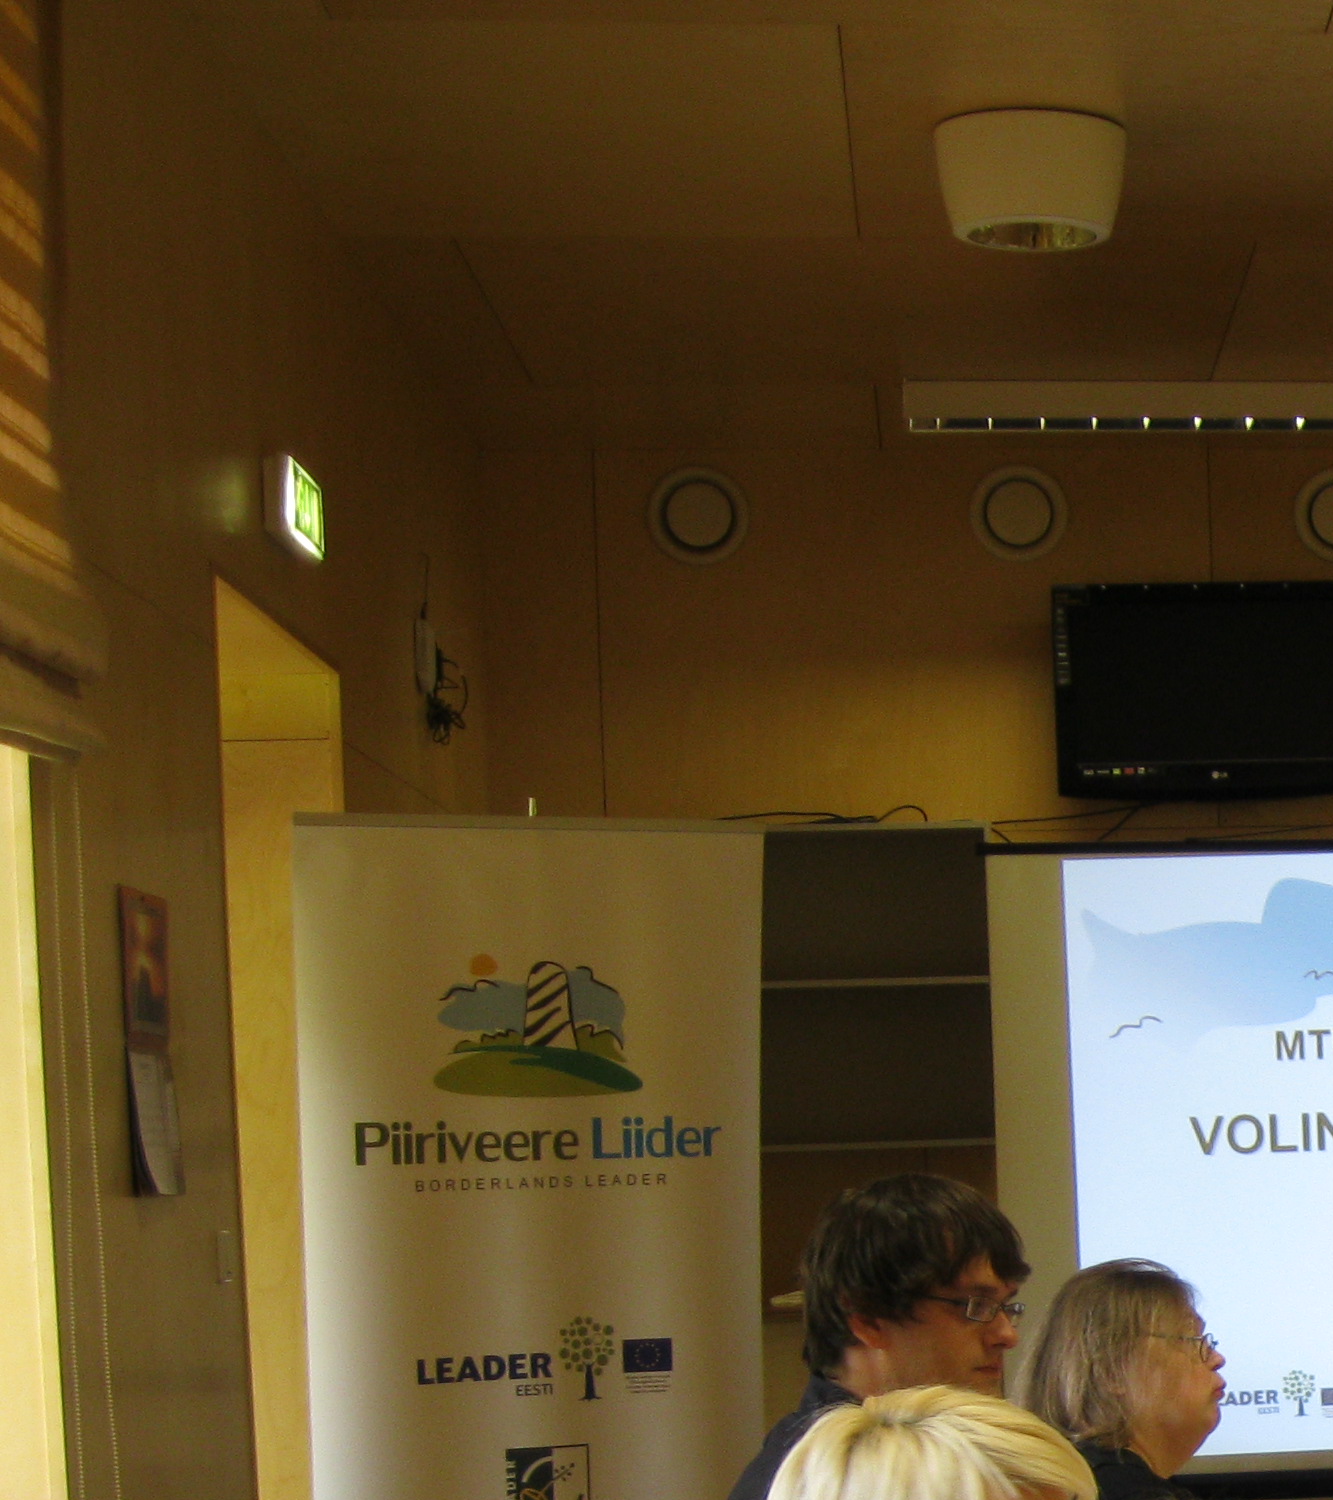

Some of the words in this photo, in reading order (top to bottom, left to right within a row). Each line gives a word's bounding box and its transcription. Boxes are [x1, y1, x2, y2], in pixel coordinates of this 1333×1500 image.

[354, 1120, 579, 1167] Piiriveere
[591, 1115, 722, 1160] Liider
[414, 1175, 574, 1193] BORDERLANDS
[584, 1172, 667, 1188] LEADER
[416, 1352, 553, 1386] LEADER
[516, 1383, 553, 1396] EESTI
[1219, 1389, 1279, 1406] ADER
